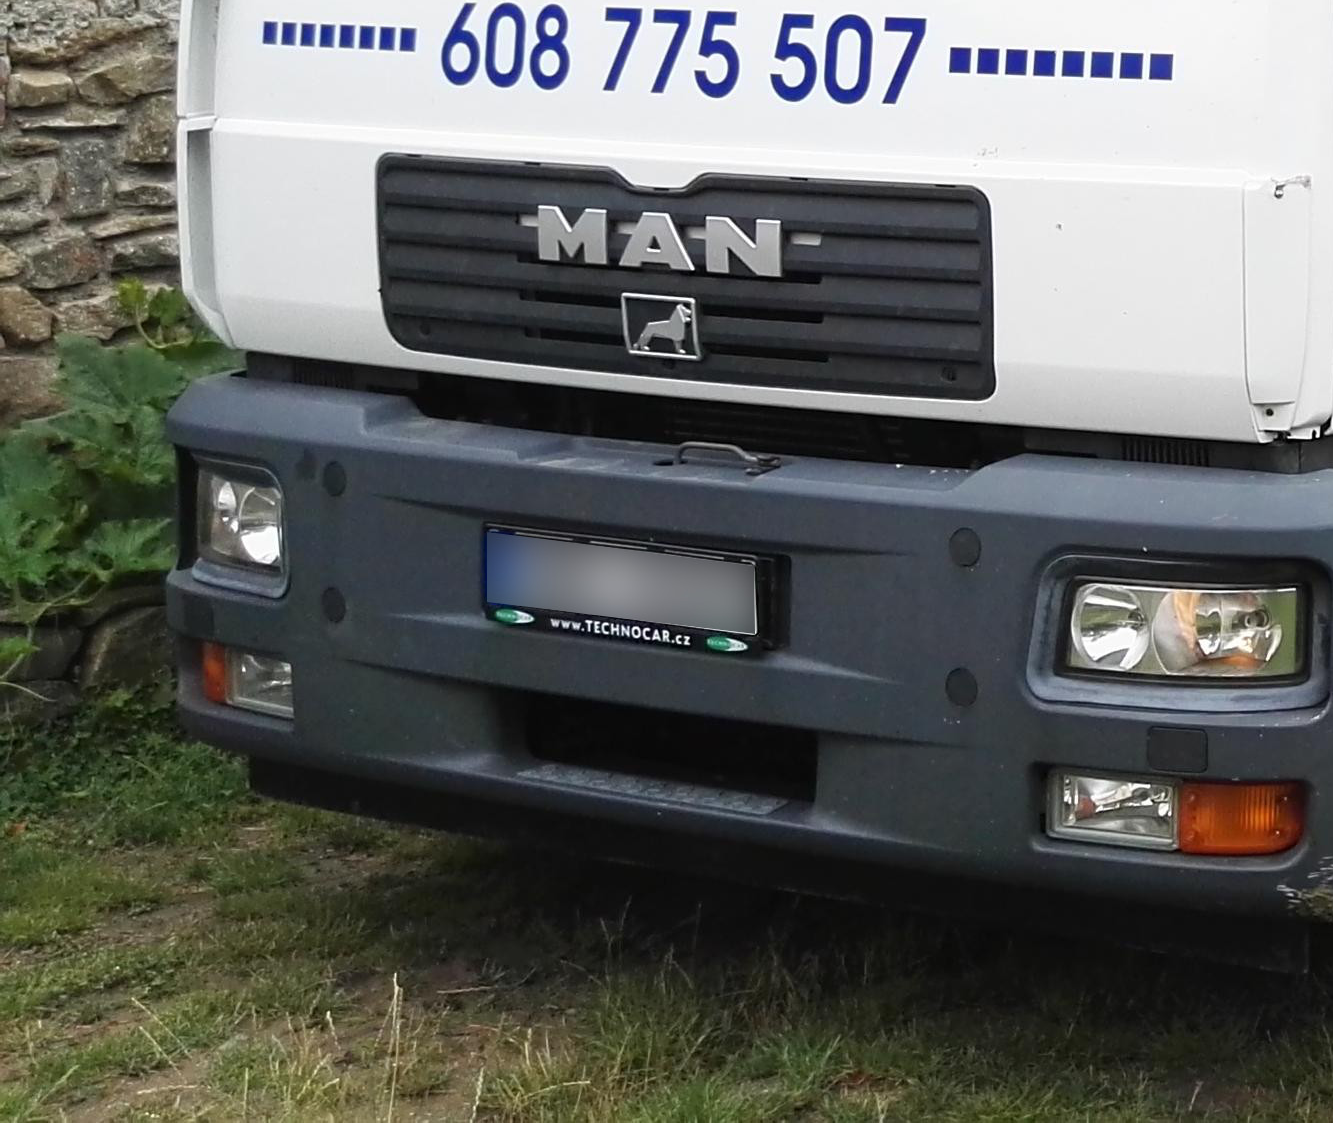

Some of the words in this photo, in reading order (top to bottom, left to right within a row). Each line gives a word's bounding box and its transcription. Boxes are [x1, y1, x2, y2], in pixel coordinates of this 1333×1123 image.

[441, 2, 570, 89] 608
[603, 7, 741, 98] 775
[769, 14, 927, 104] 507
[536, 204, 783, 277] MAN
[550, 618, 691, 647] www.TECHNOCAR.cz
